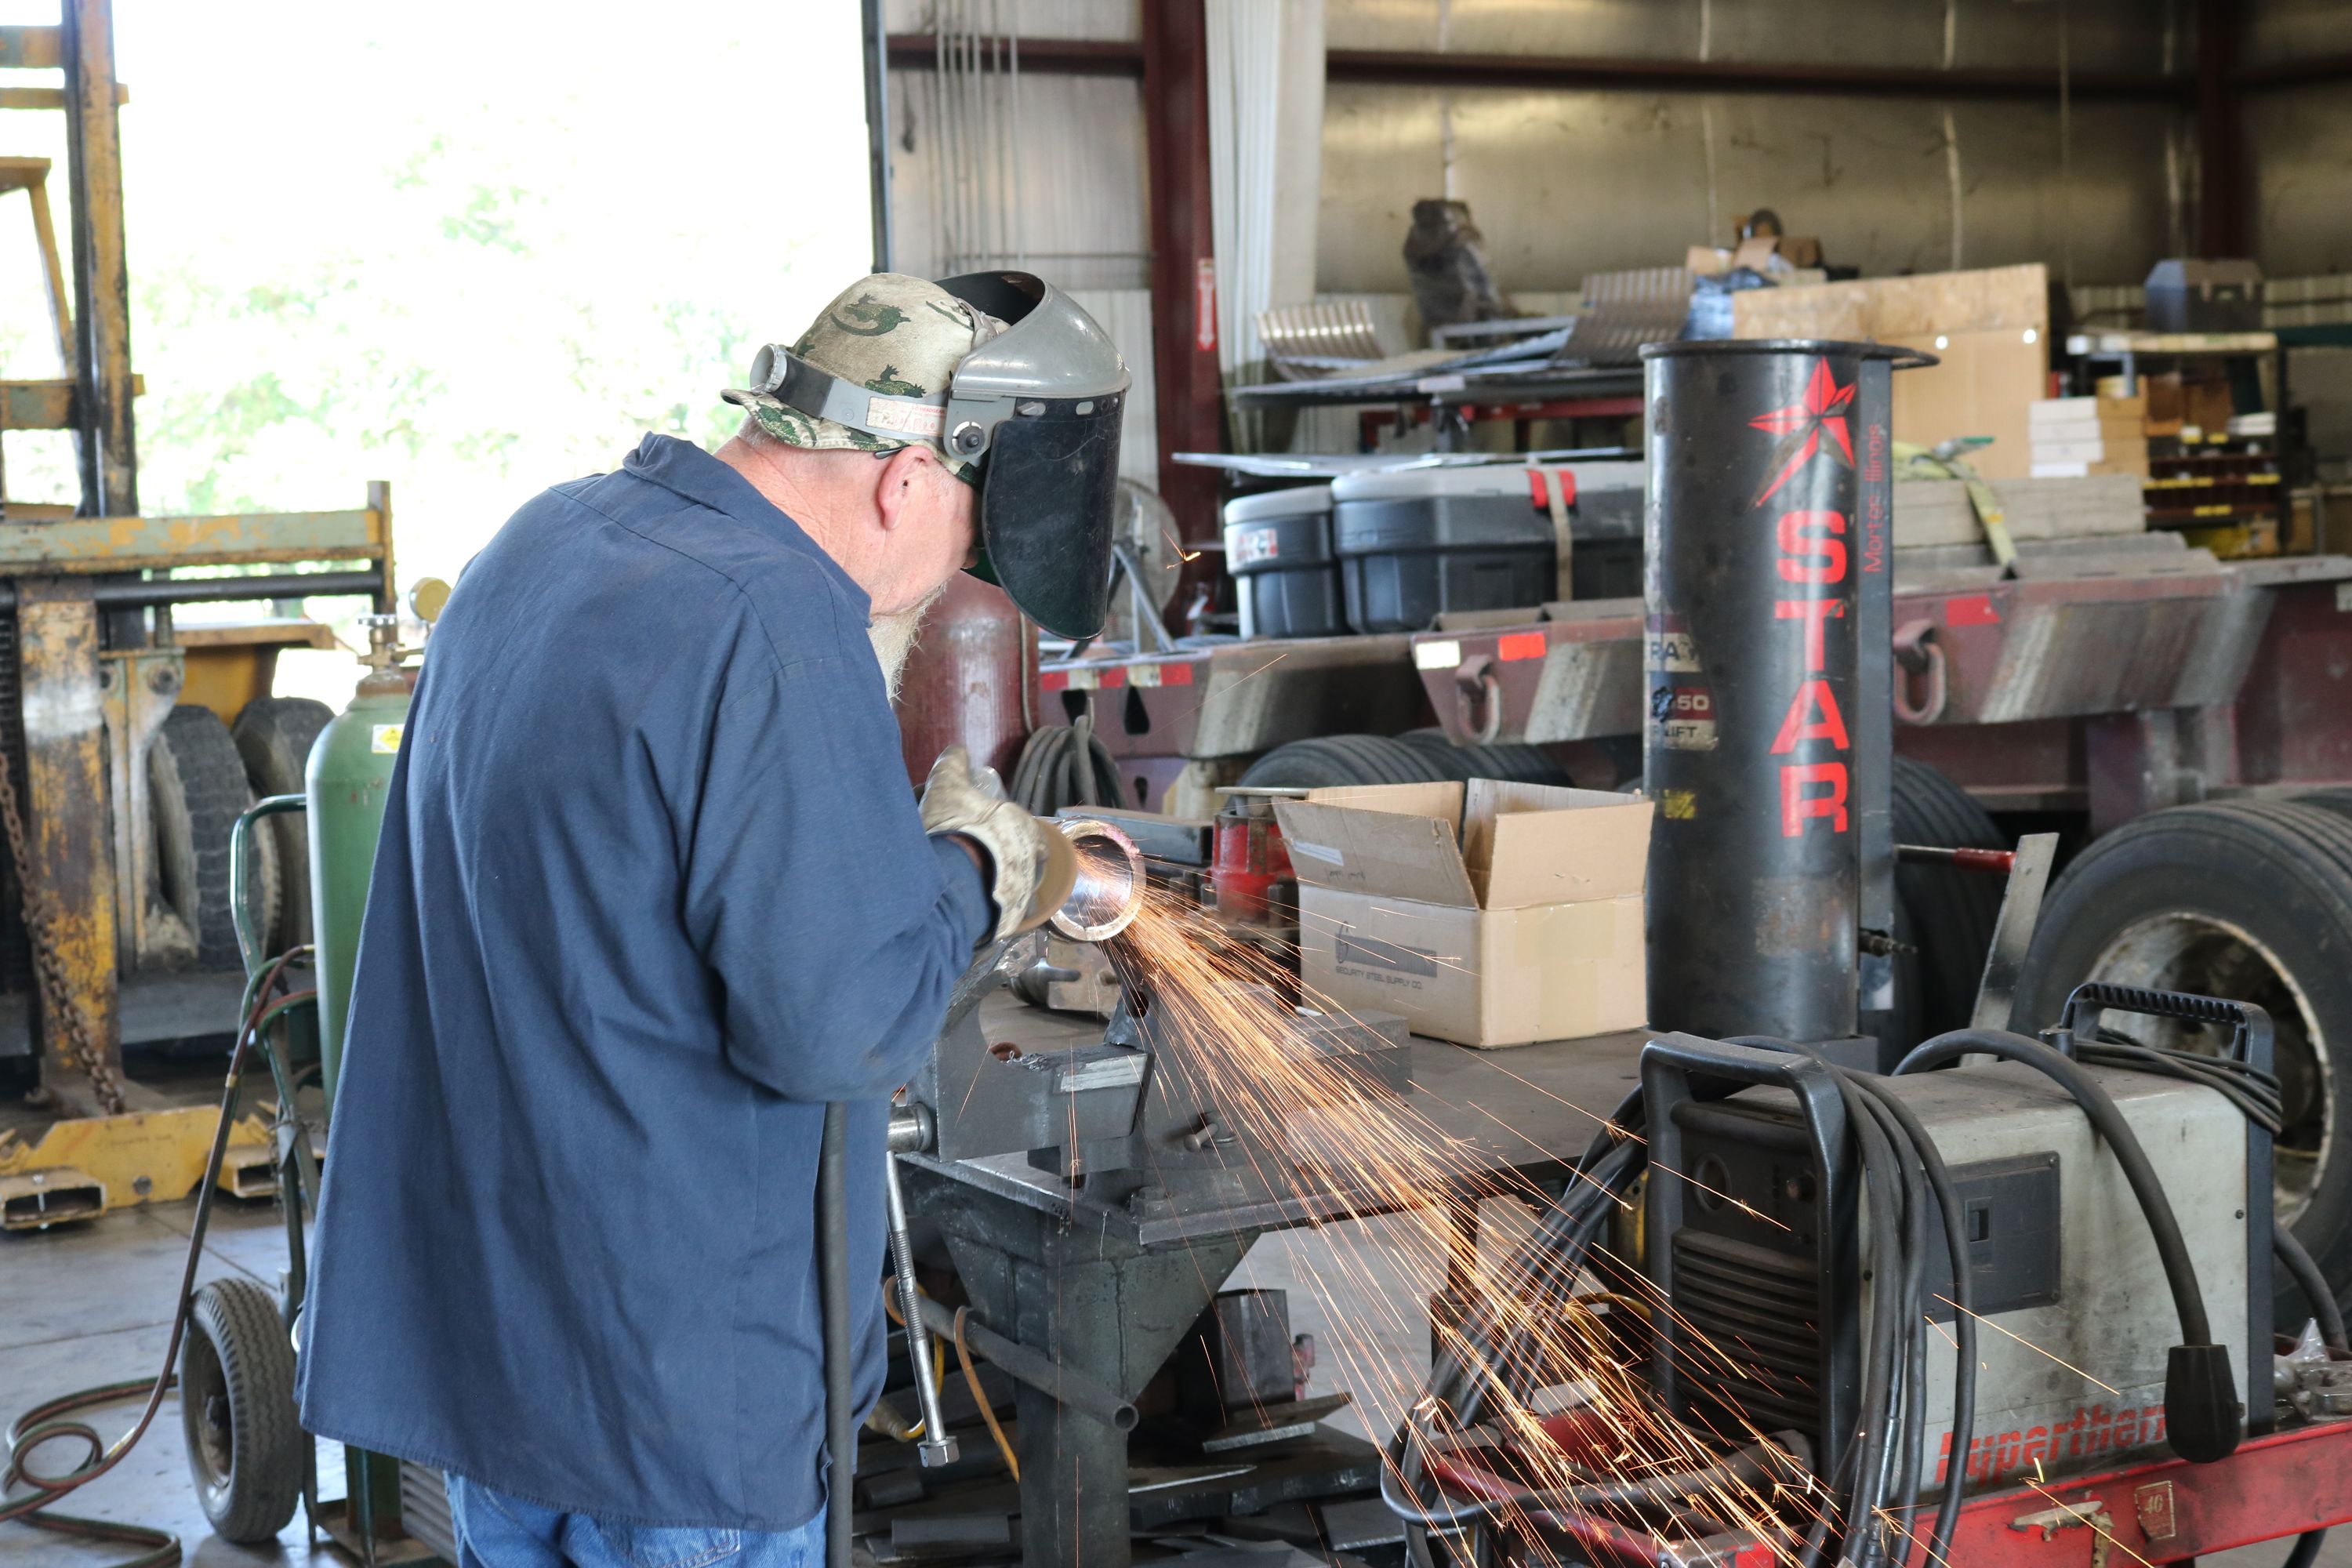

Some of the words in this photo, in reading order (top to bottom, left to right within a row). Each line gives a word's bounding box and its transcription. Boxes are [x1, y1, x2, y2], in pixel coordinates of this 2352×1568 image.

[1864, 423, 1883, 482] Illinois
[1769, 510, 1850, 838] STAR
[1385, 975, 1410, 987] SUPPLY
